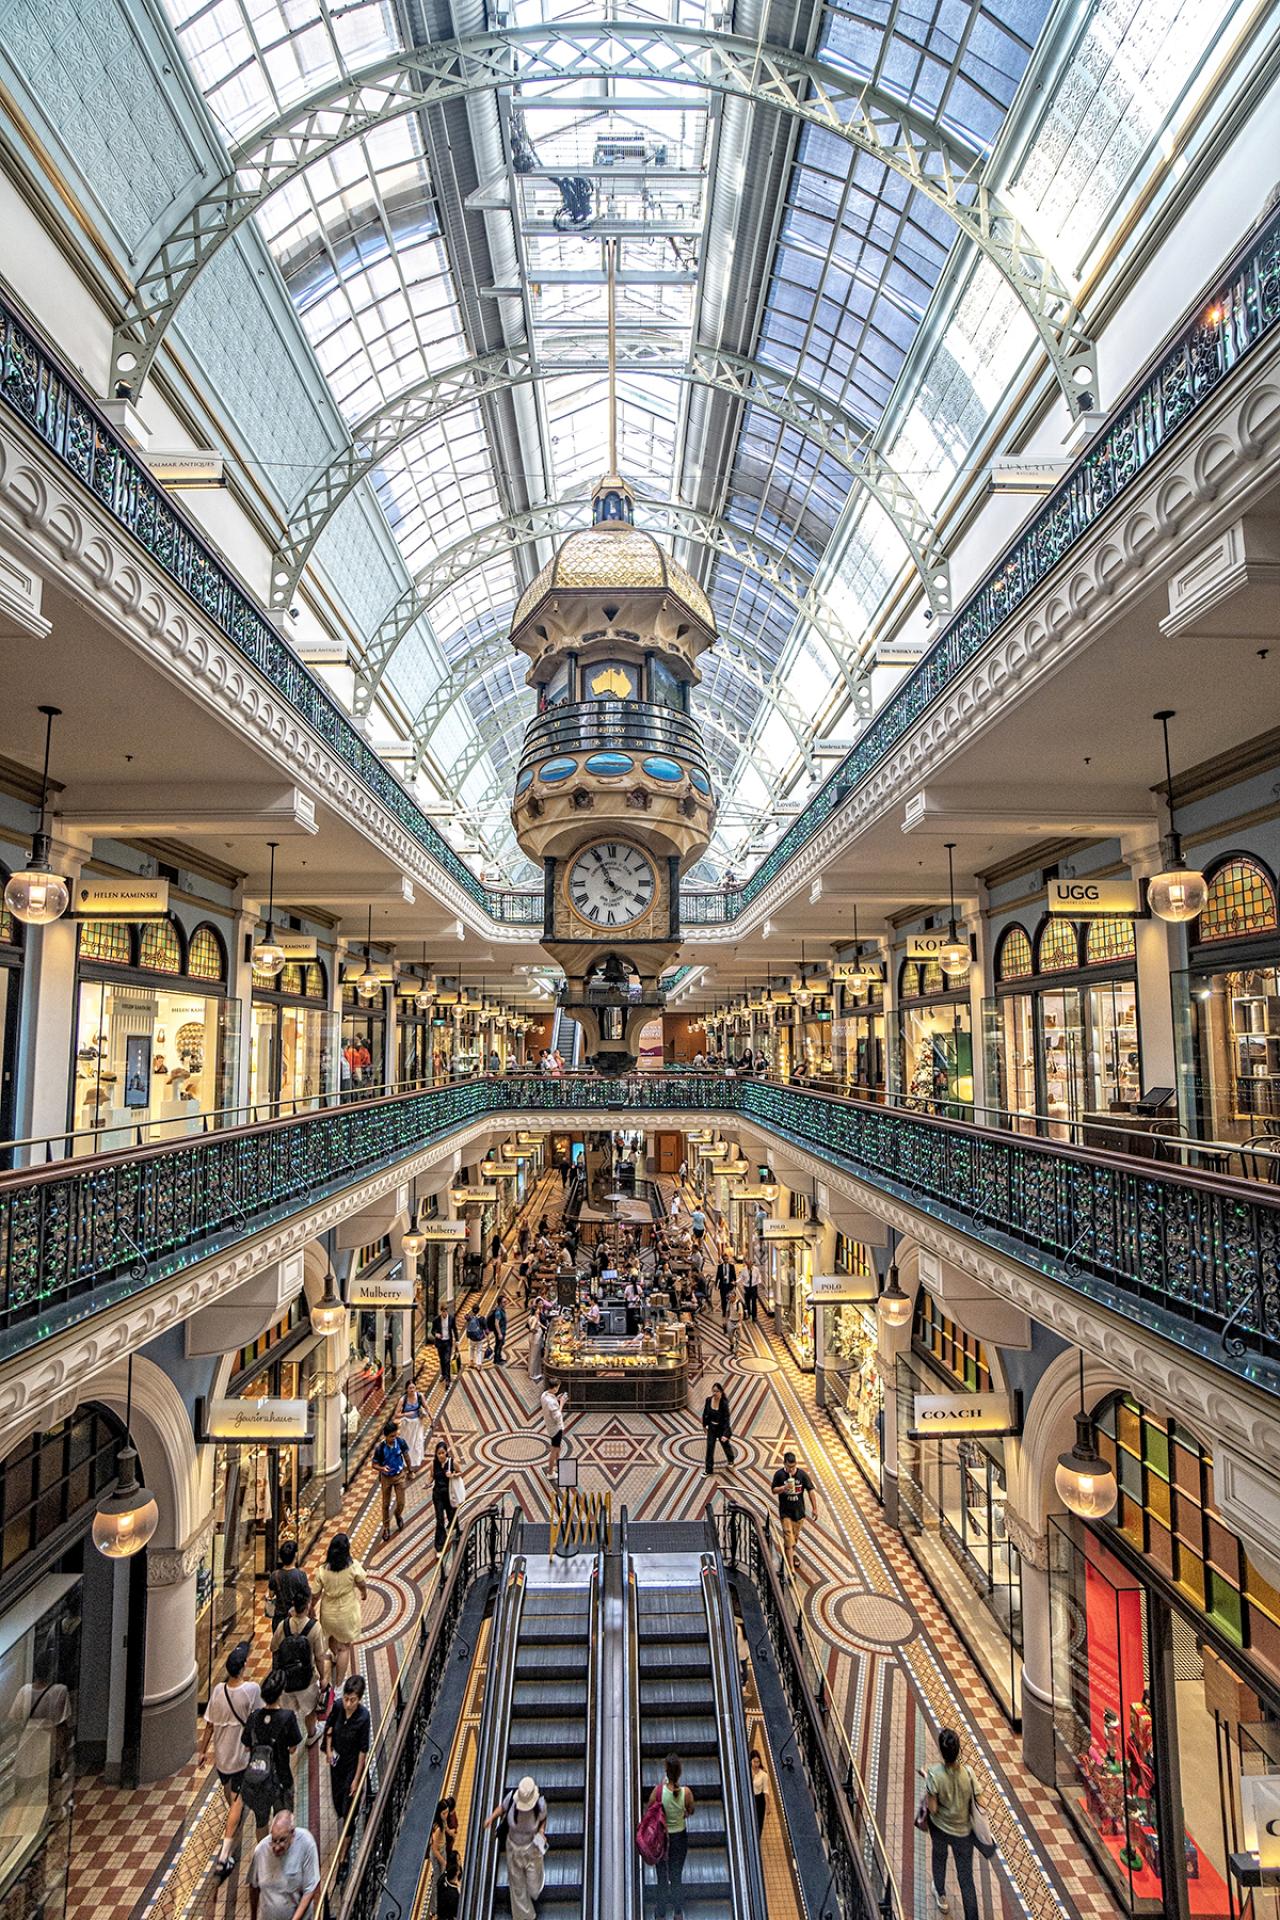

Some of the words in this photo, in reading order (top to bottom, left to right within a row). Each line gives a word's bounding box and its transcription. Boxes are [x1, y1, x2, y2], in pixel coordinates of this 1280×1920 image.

[1056, 885, 1100, 900] UGG
[426, 1225, 457, 1235] Mulberry
[360, 1287, 402, 1299] Mulberry
[821, 1283, 842, 1291] POLO
[921, 1408, 983, 1421] COACH
